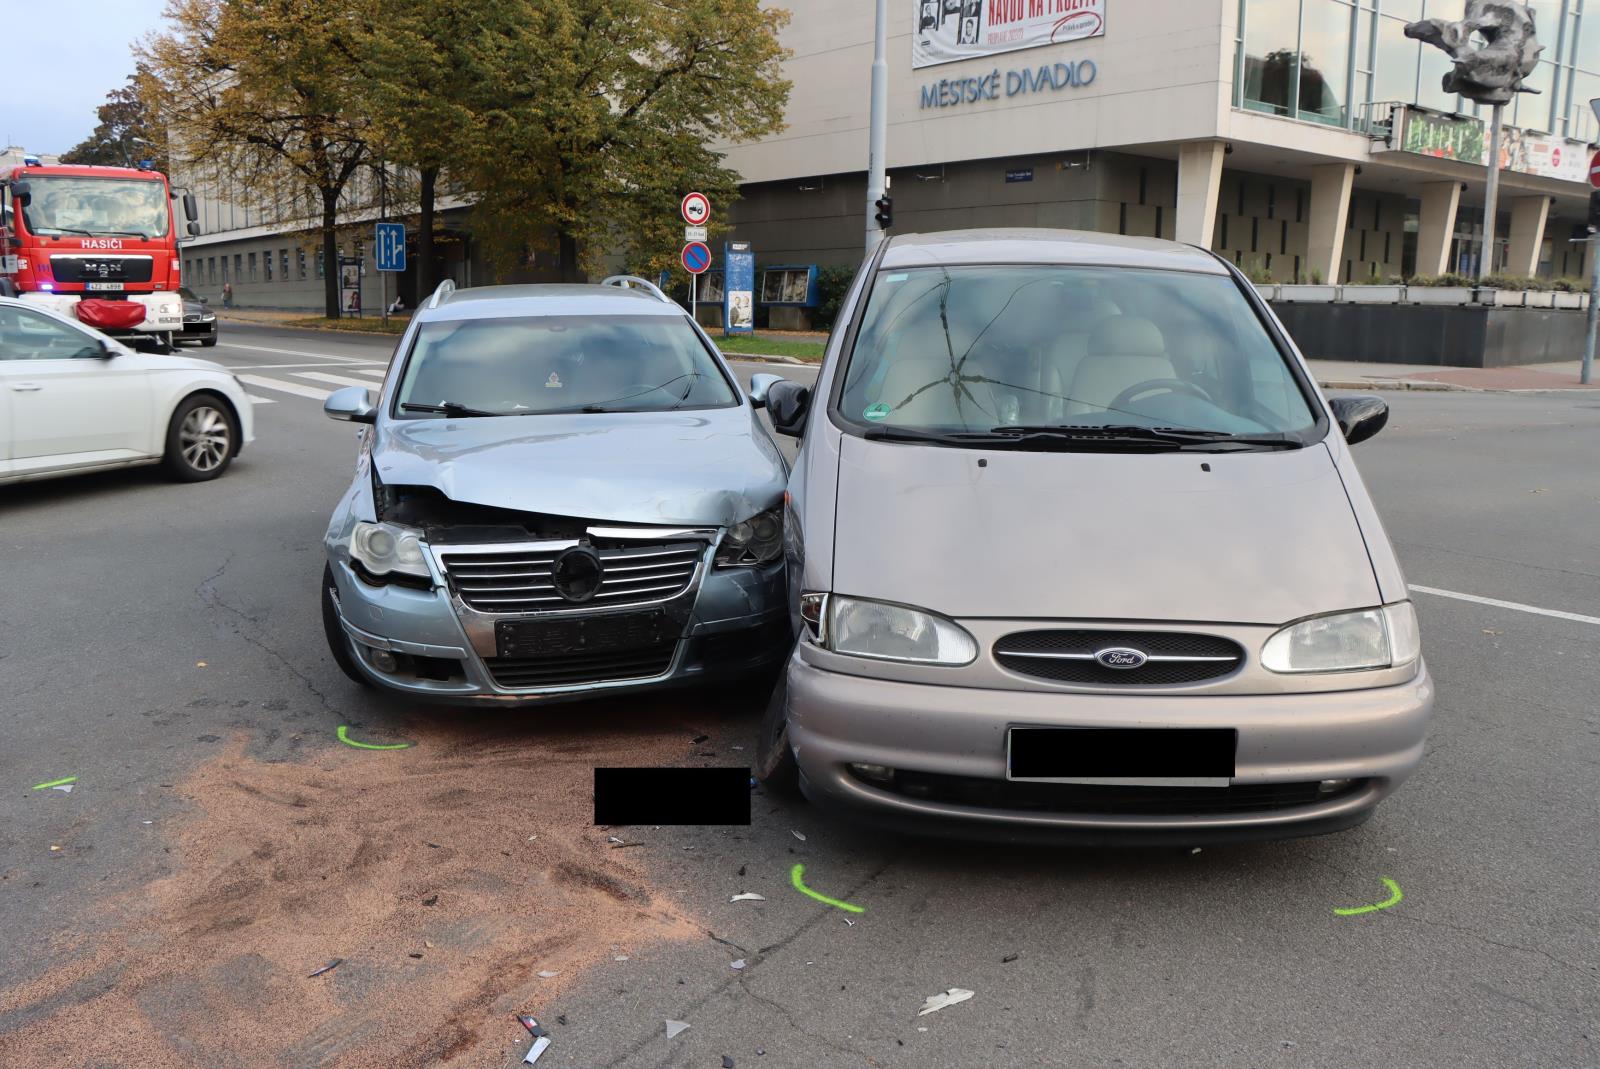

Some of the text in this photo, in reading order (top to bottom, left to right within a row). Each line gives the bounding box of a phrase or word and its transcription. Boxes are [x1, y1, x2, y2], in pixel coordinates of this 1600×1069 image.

[920, 59, 1097, 109] MĚSTSKÉ DIVADLO
[81, 238, 123, 249] HASIČI
[85, 263, 122, 272] MAN
[1108, 652, 1135, 664] Ford
